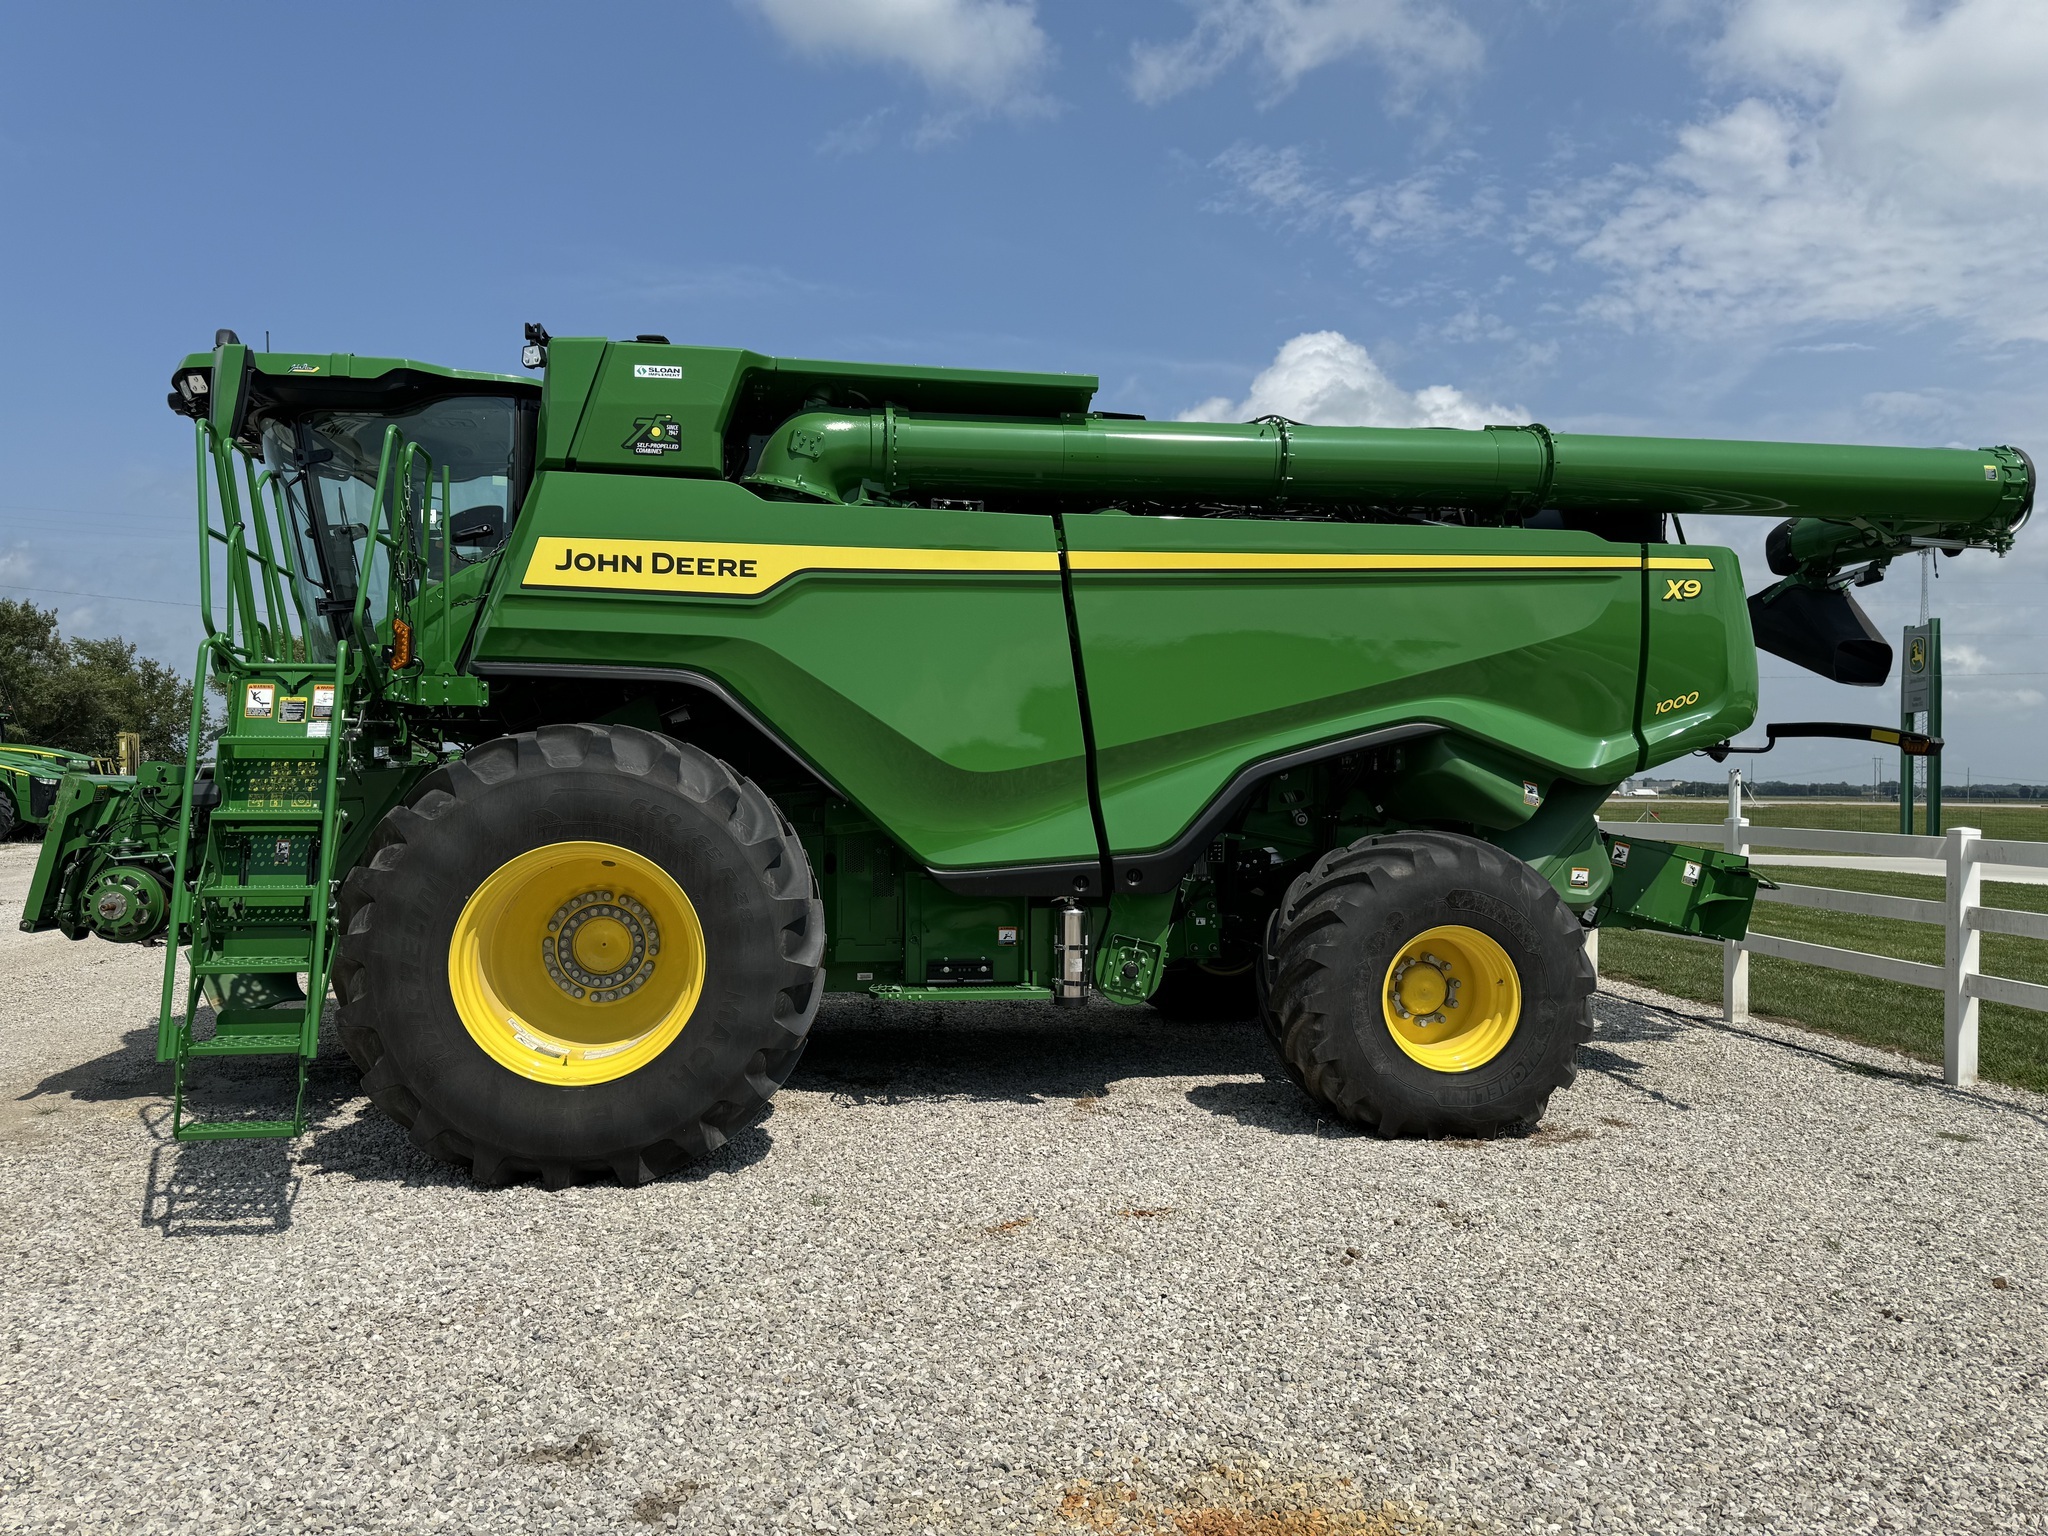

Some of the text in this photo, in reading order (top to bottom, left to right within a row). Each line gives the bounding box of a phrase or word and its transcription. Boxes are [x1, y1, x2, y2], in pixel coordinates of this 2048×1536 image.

[636, 442, 679, 450] SELF-PROPELLED
[555, 548, 758, 578] JOHN DEERE
[1662, 579, 1702, 601] X9
[1655, 691, 1699, 715] 1000
